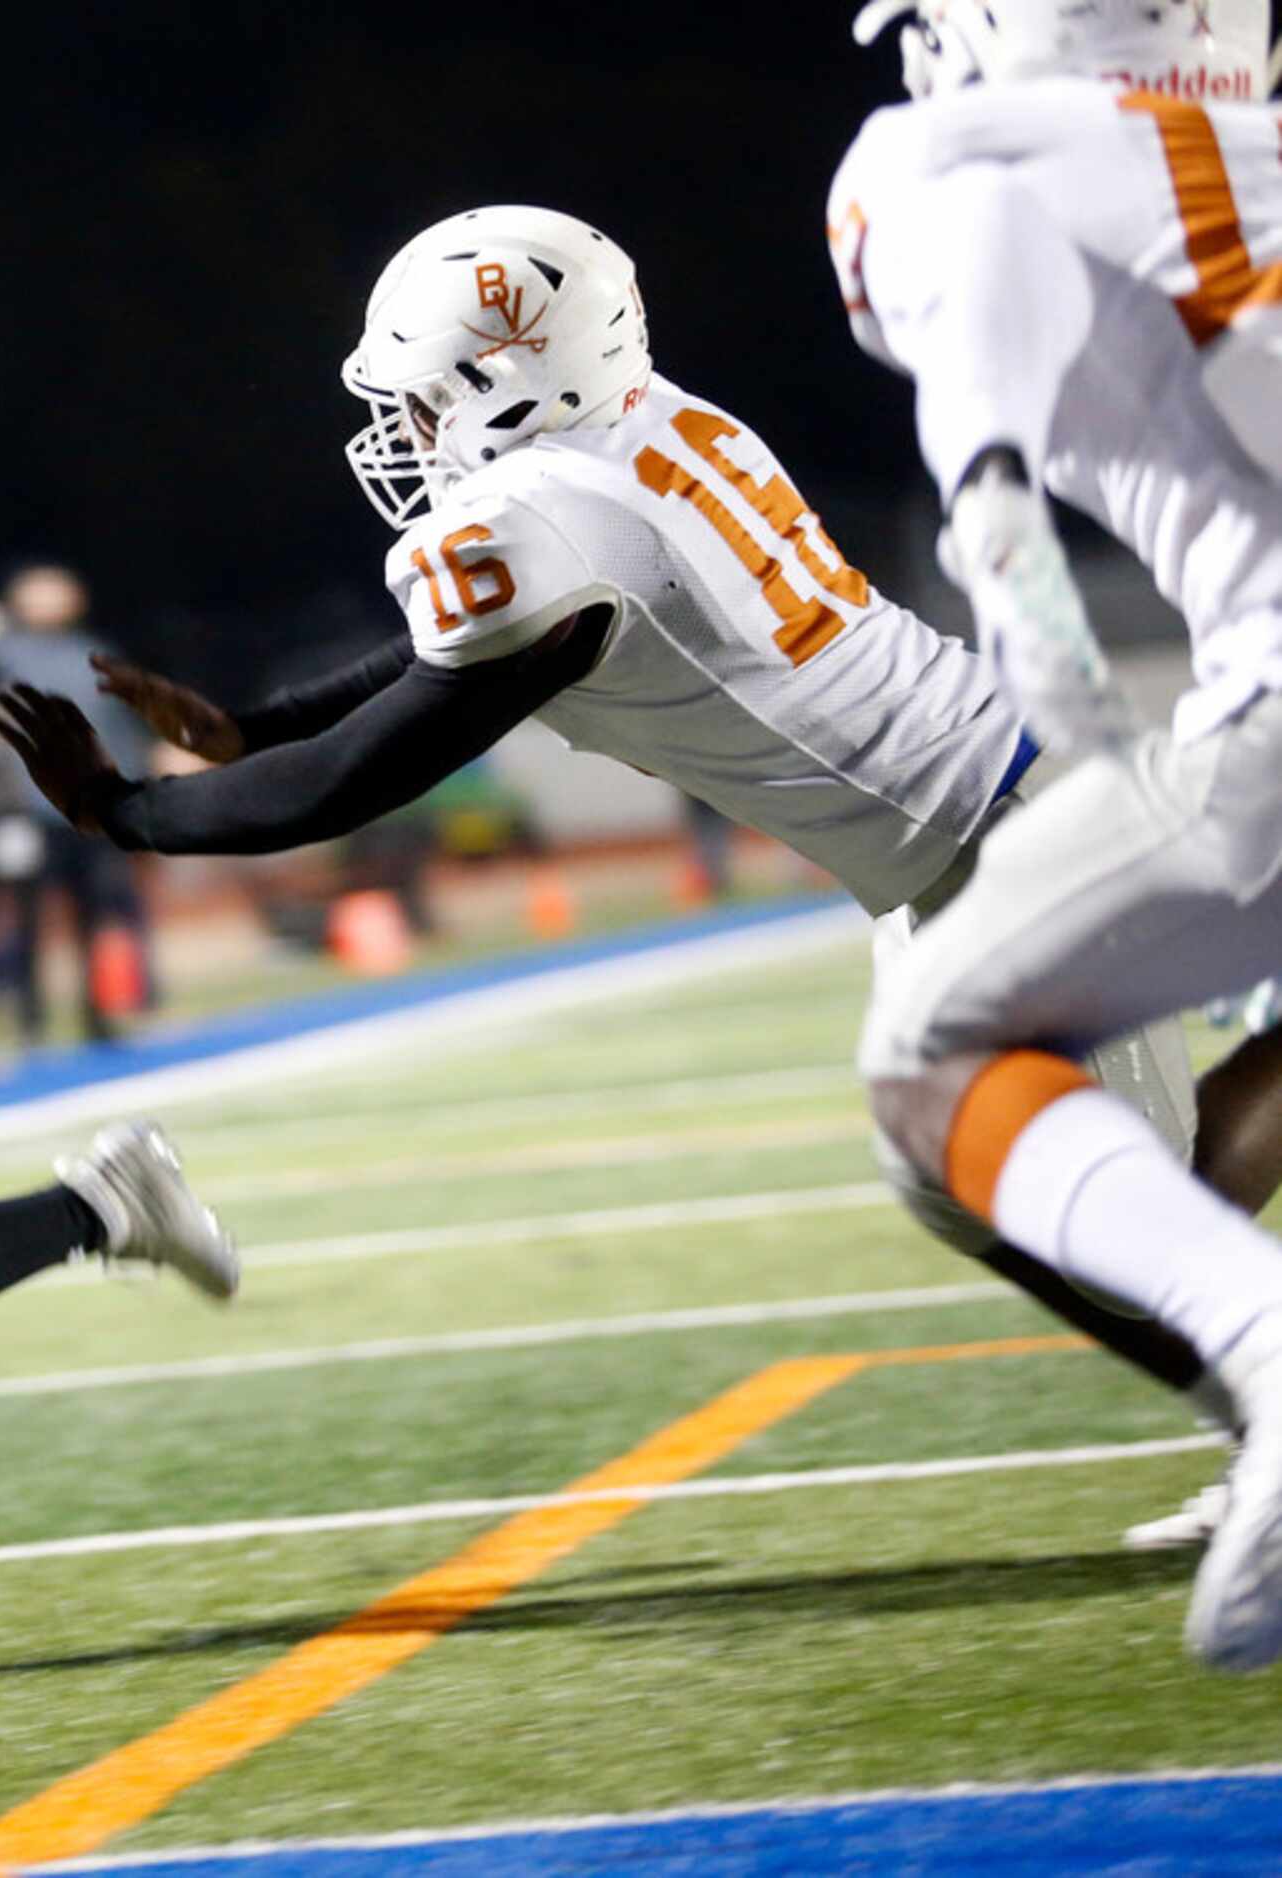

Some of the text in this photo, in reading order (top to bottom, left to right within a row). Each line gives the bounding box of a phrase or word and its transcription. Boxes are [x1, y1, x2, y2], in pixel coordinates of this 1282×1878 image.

[476, 263, 523, 335] BV
[410, 523, 516, 635] 16
[632, 407, 870, 670] 16
